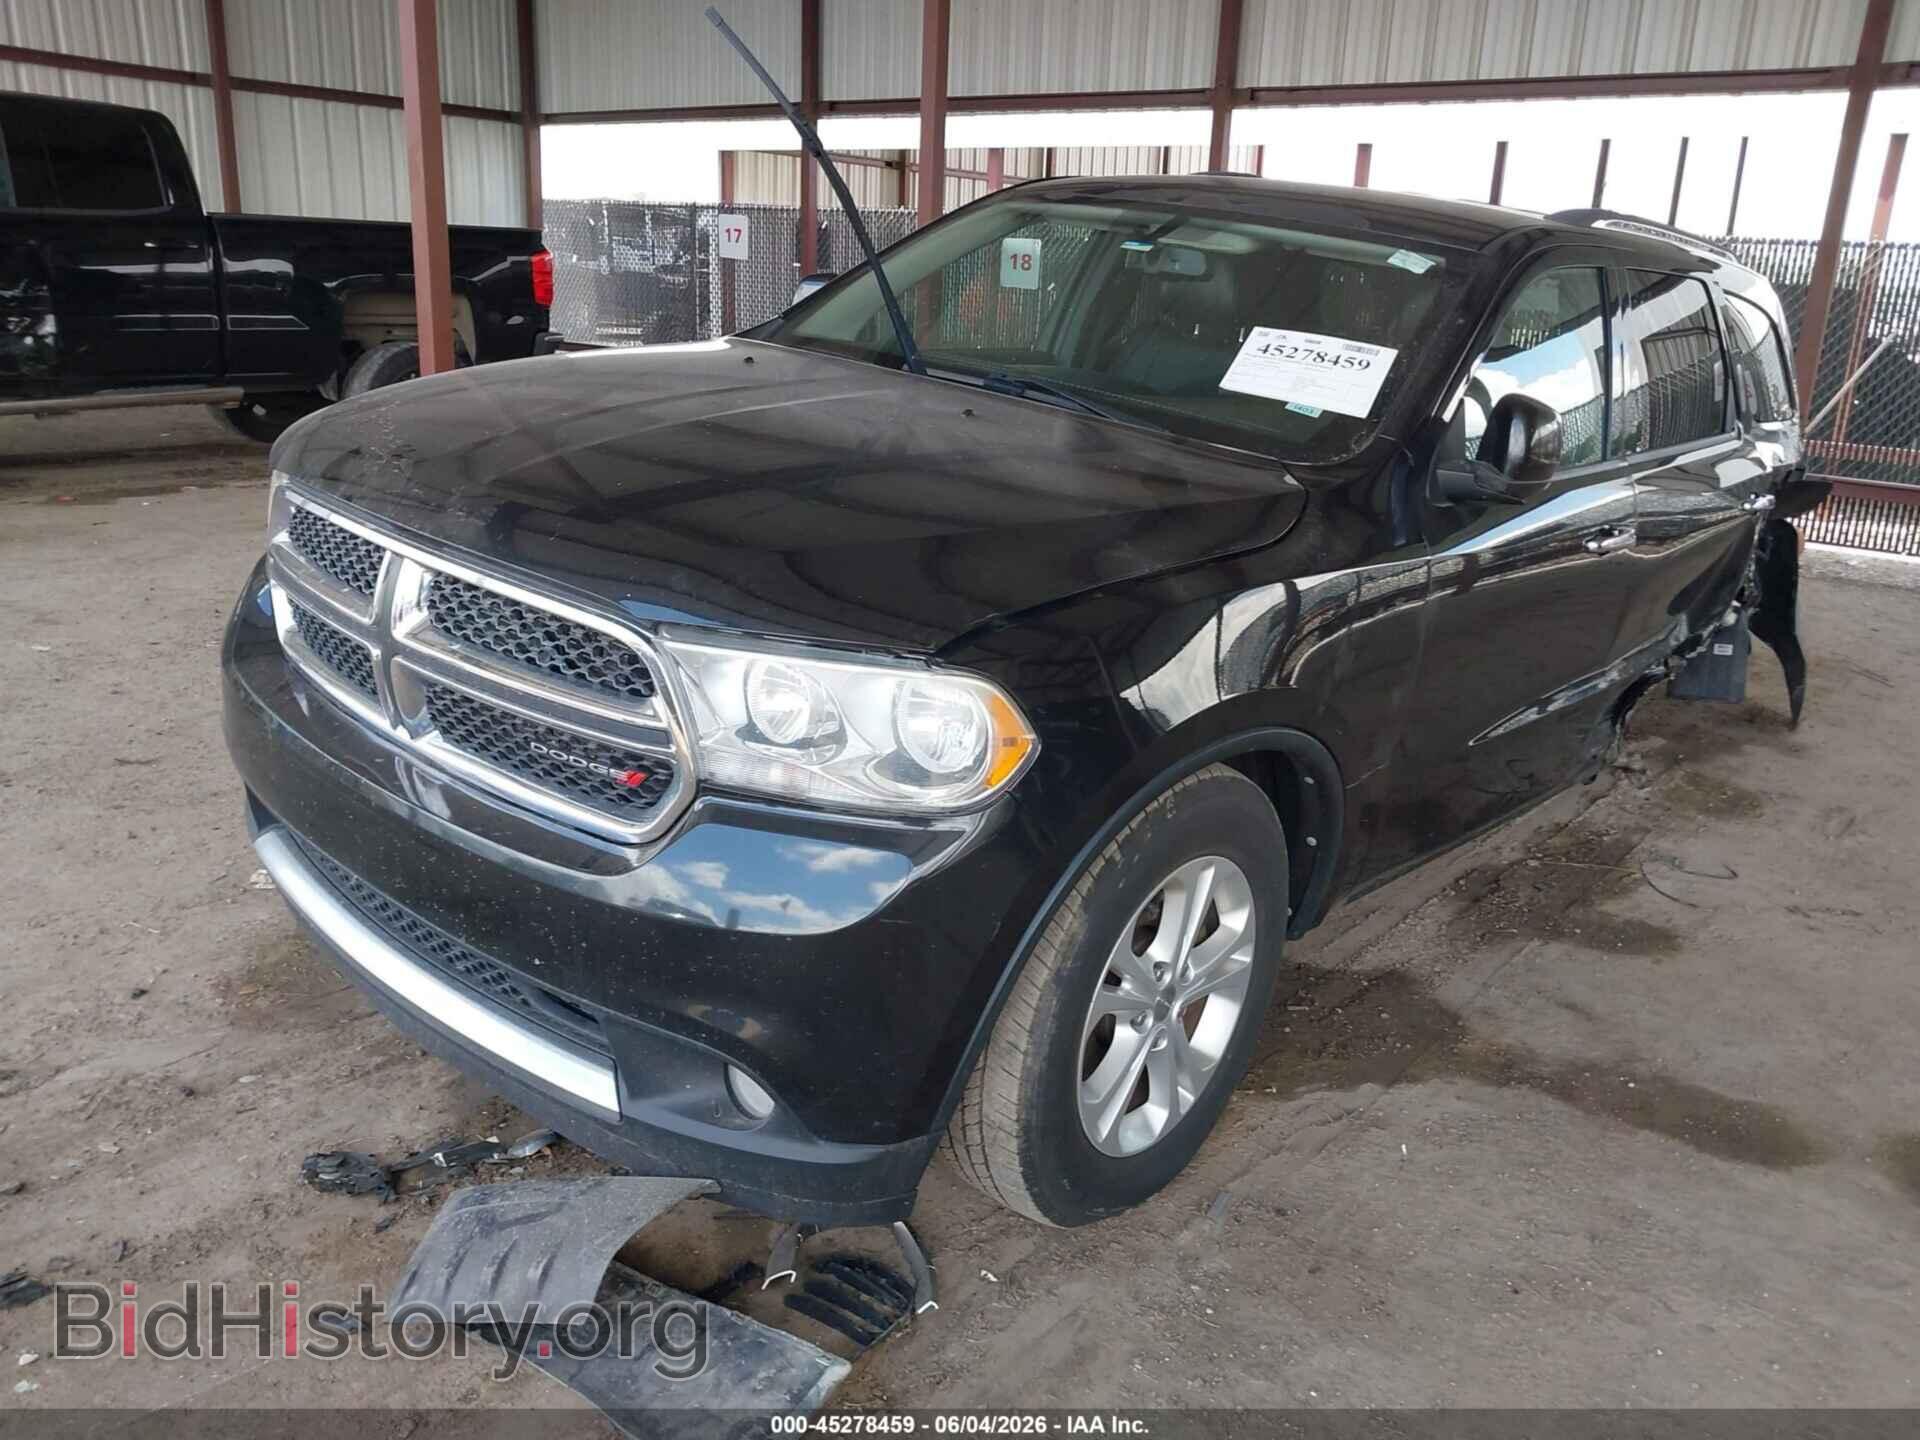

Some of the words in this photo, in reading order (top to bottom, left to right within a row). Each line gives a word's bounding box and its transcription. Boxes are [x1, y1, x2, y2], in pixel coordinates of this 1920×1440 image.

[725, 228, 742, 243] 17
[1010, 254, 1032, 271] 18
[1256, 343, 1371, 371] 45278459
[530, 742, 627, 782] DODGE
